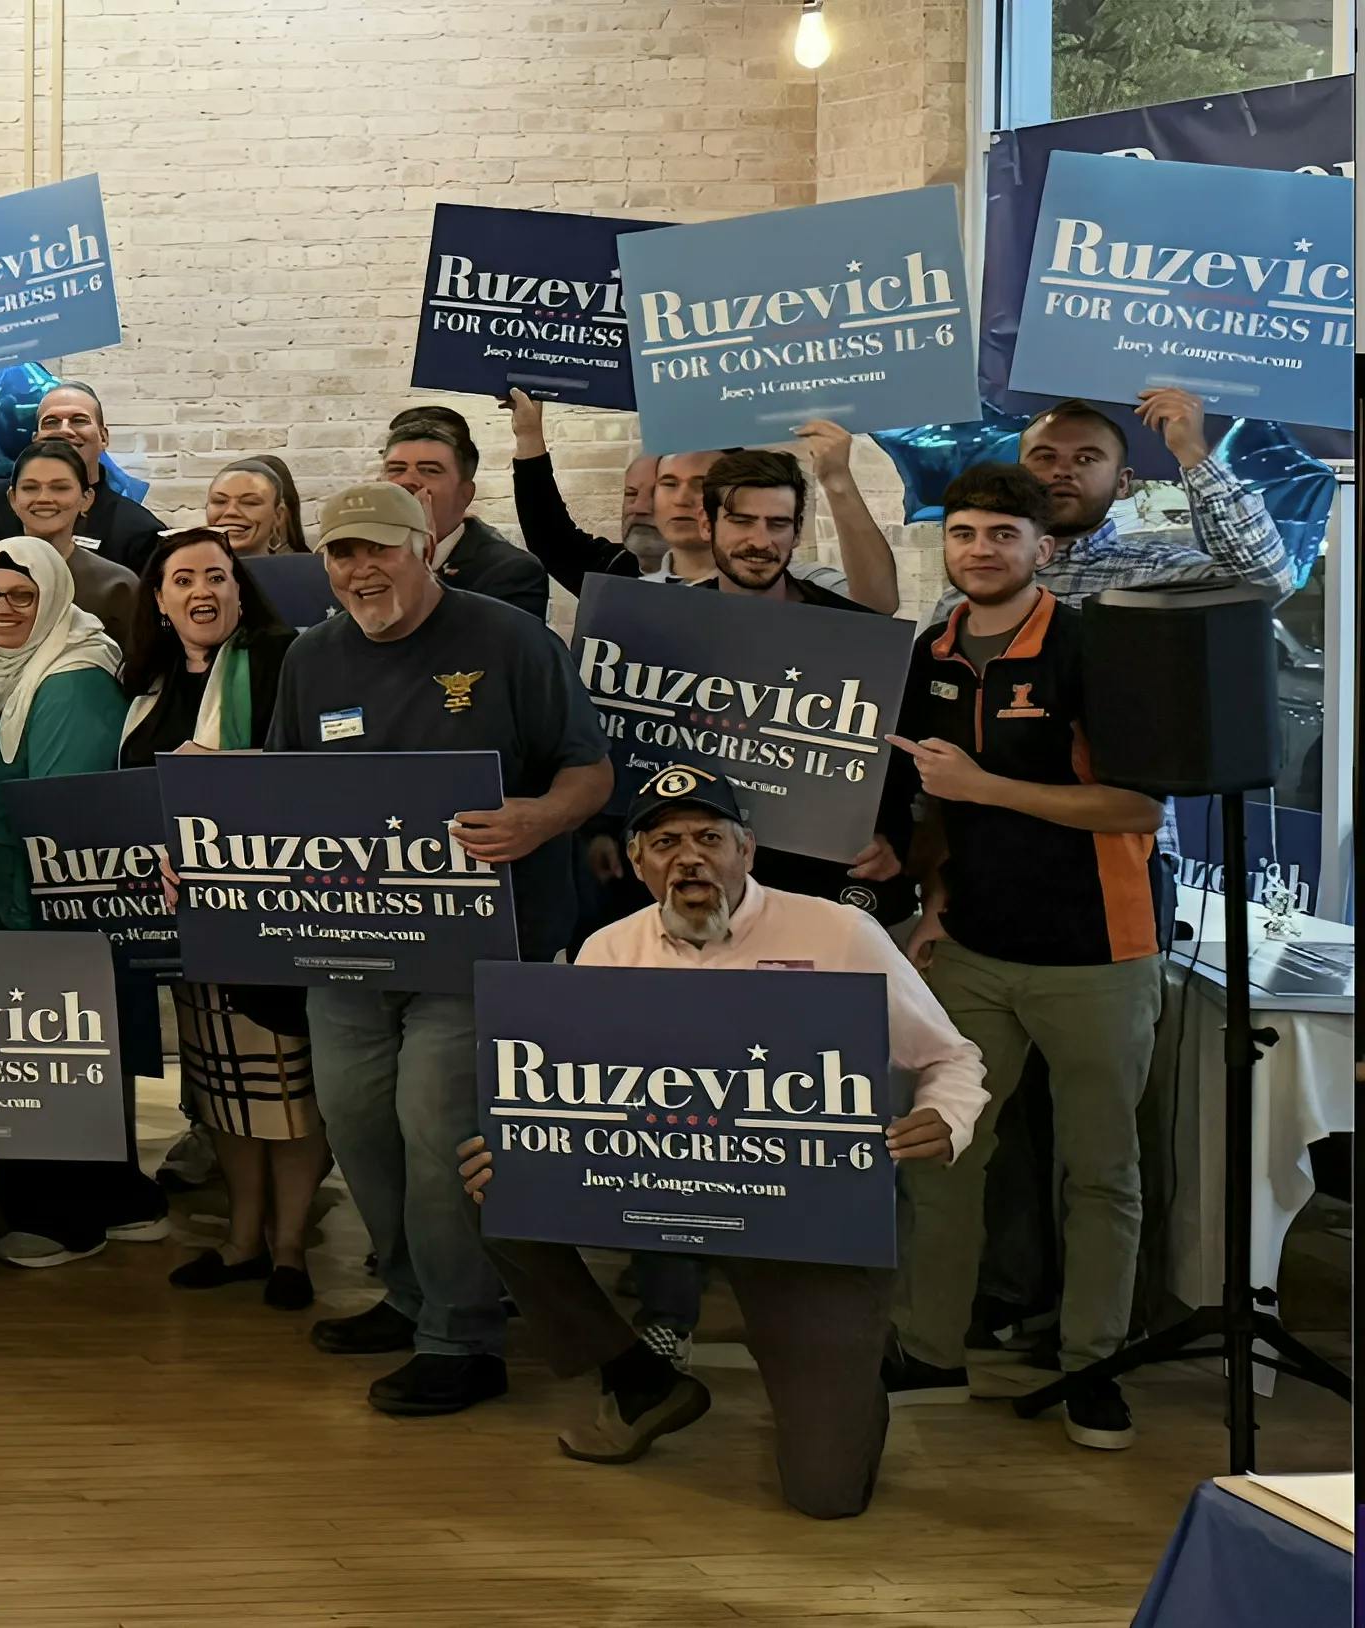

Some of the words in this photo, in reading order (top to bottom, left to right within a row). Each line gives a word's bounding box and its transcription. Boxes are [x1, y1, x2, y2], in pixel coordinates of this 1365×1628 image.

[435, 254, 626, 313] Ruzevi
[1047, 218, 1355, 301] Ruzevic
[639, 251, 955, 343] Ruzevich
[1045, 292, 1111, 322] FOR
[1124, 301, 1310, 343] CONGRESS
[433, 311, 481, 334] FOR
[489, 317, 623, 348] CONGRESS
[652, 358, 710, 384] FOR
[719, 332, 884, 373] CONGRESS
[578, 636, 880, 740] Ruzevich
[635, 719, 796, 770] CONGRESS
[804, 750, 866, 783] IL-6
[41, 898, 87, 921] FOR
[188, 885, 246, 911] FOR
[257, 886, 423, 916] CONGRESS
[433, 892, 495, 918] IL-6
[492, 1038, 878, 1117] Ruzevich
[501, 1123, 573, 1154] FOR
[584, 1127, 787, 1166] CONGRESS
[799, 1138, 874, 1170] IL-6
